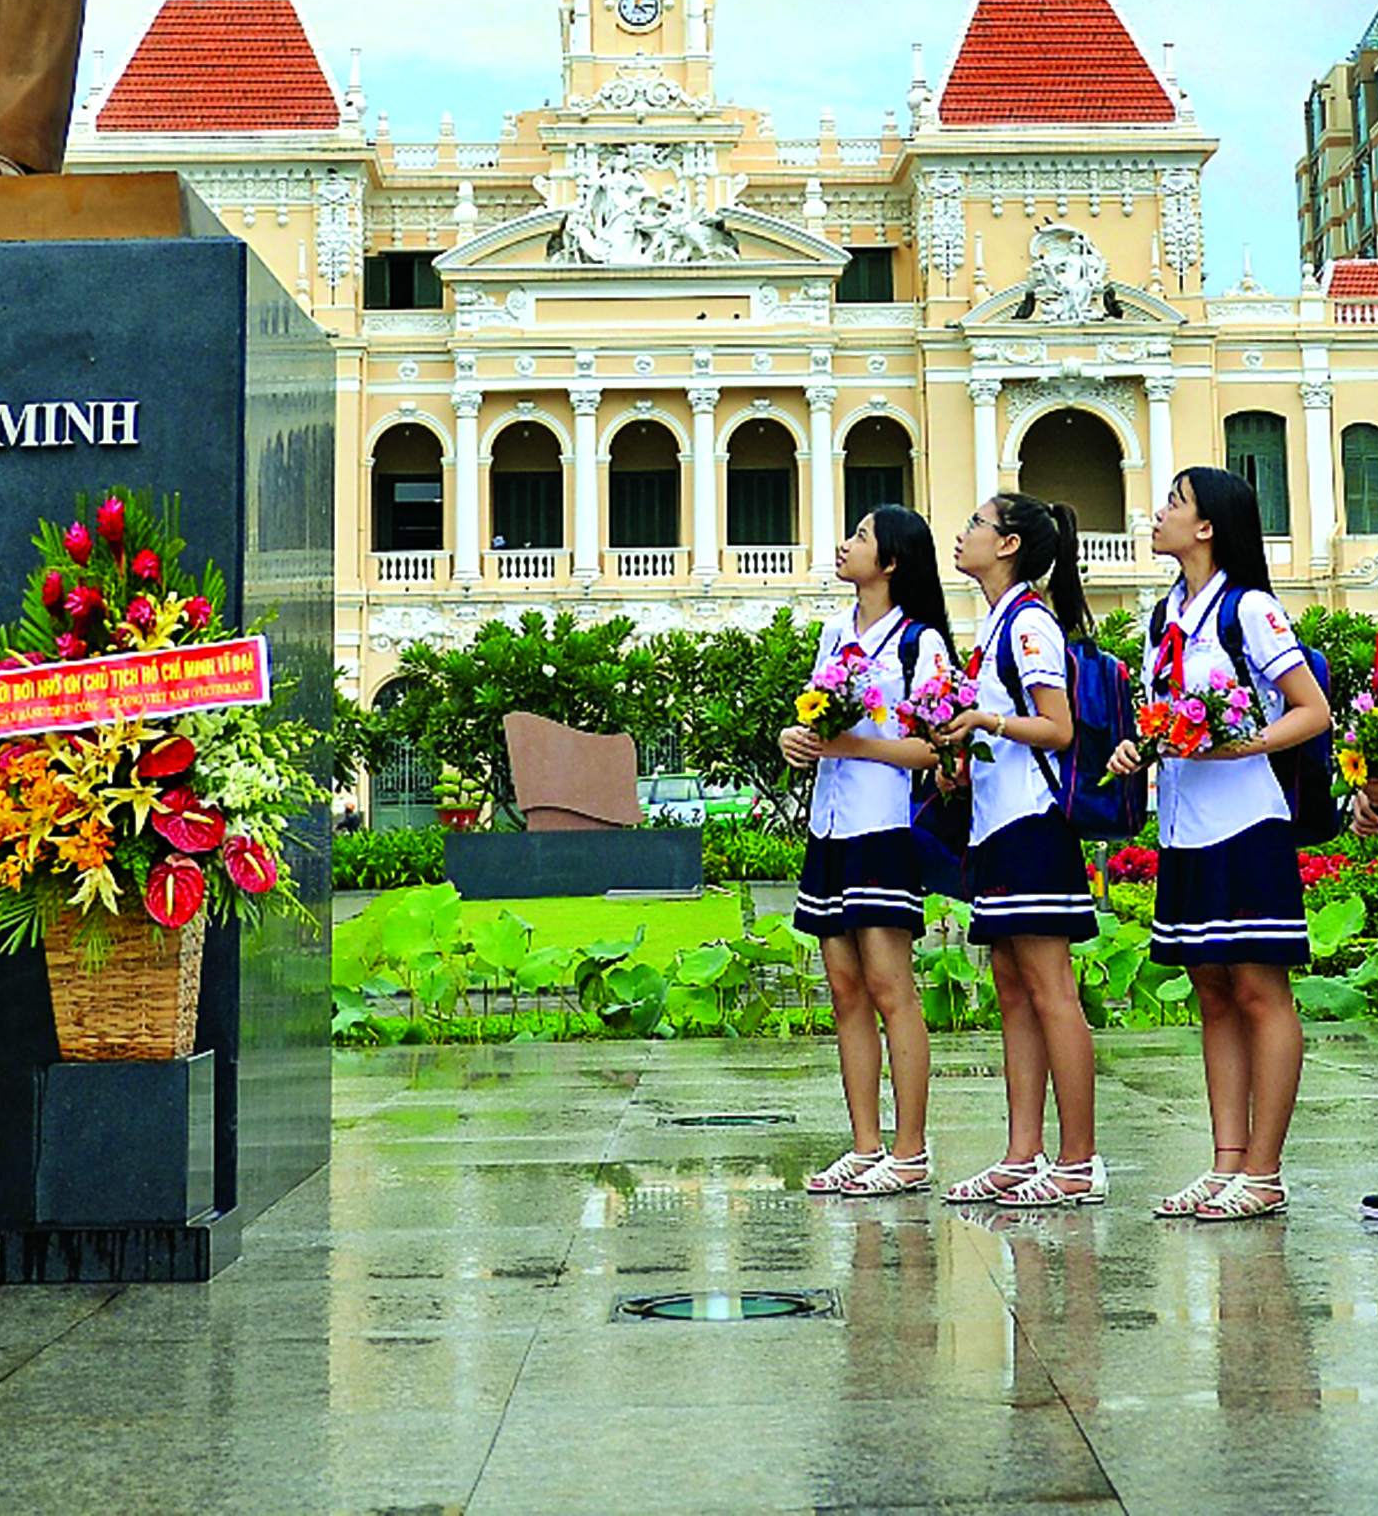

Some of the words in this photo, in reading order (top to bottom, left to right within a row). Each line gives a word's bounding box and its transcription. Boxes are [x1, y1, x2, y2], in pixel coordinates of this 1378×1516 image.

[84, 666, 109, 691] CHỦ
[110, 669, 139, 691] TỊCH
[162, 656, 182, 681] CHÍ
